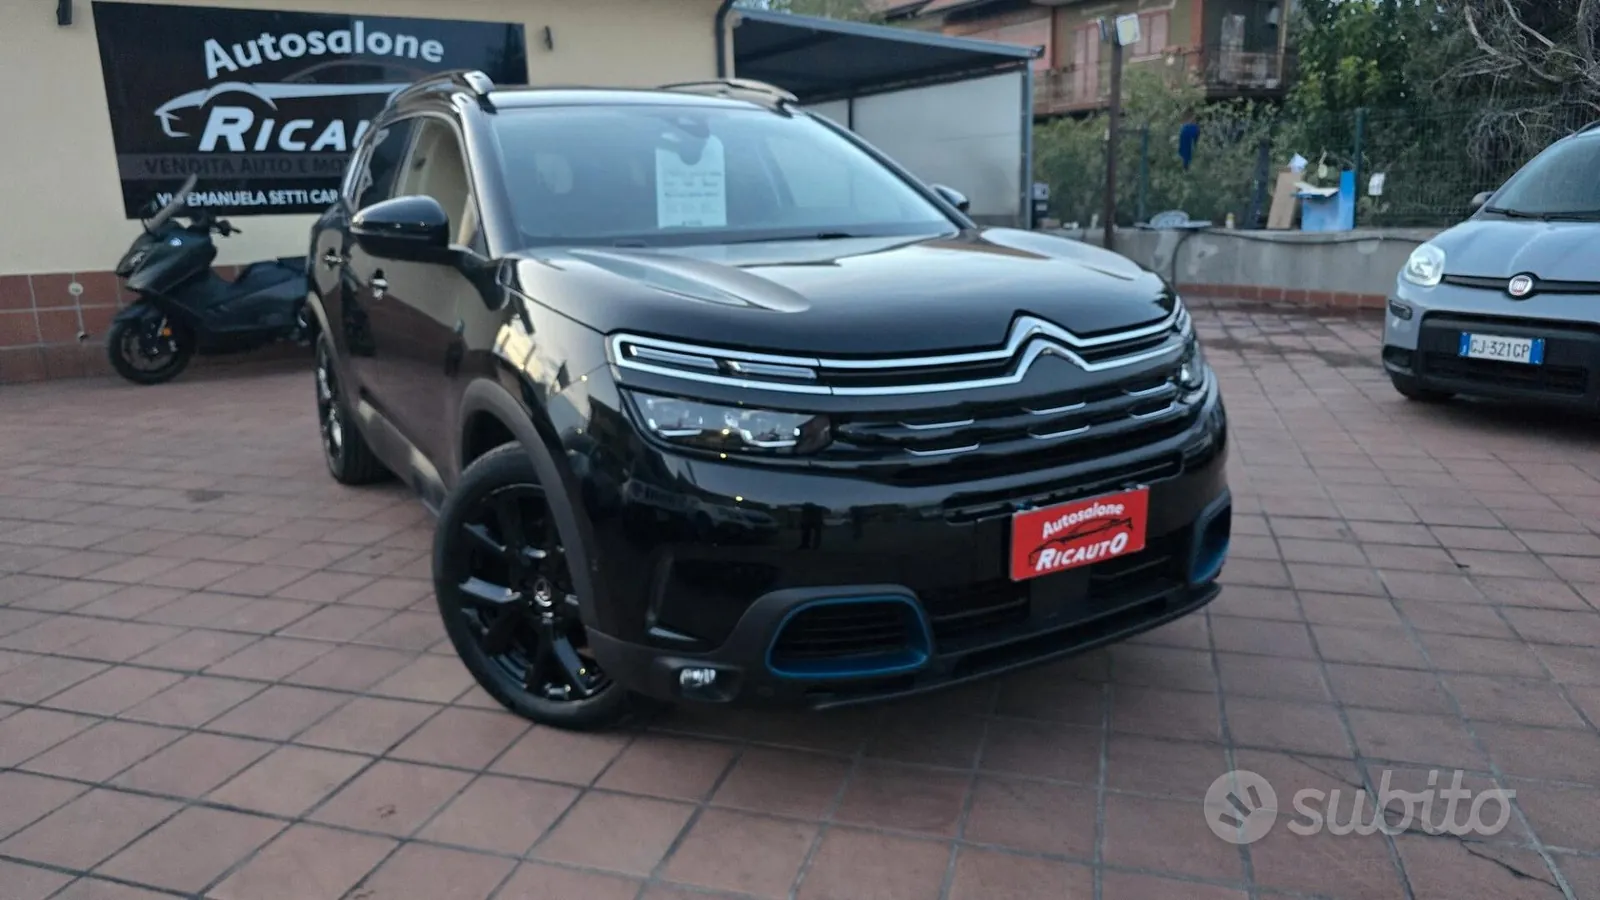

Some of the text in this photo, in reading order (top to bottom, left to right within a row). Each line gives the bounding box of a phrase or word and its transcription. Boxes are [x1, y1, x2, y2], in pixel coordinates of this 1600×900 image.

[203, 20, 445, 80] Autosalone
[145, 157, 235, 175] VENDITA
[240, 157, 292, 174] AUTO
[186, 190, 269, 207] EMANUELA
[269, 189, 308, 205] SETTI
[1042, 501, 1125, 539] Autosalone
[1035, 531, 1129, 572] RICAUTO
